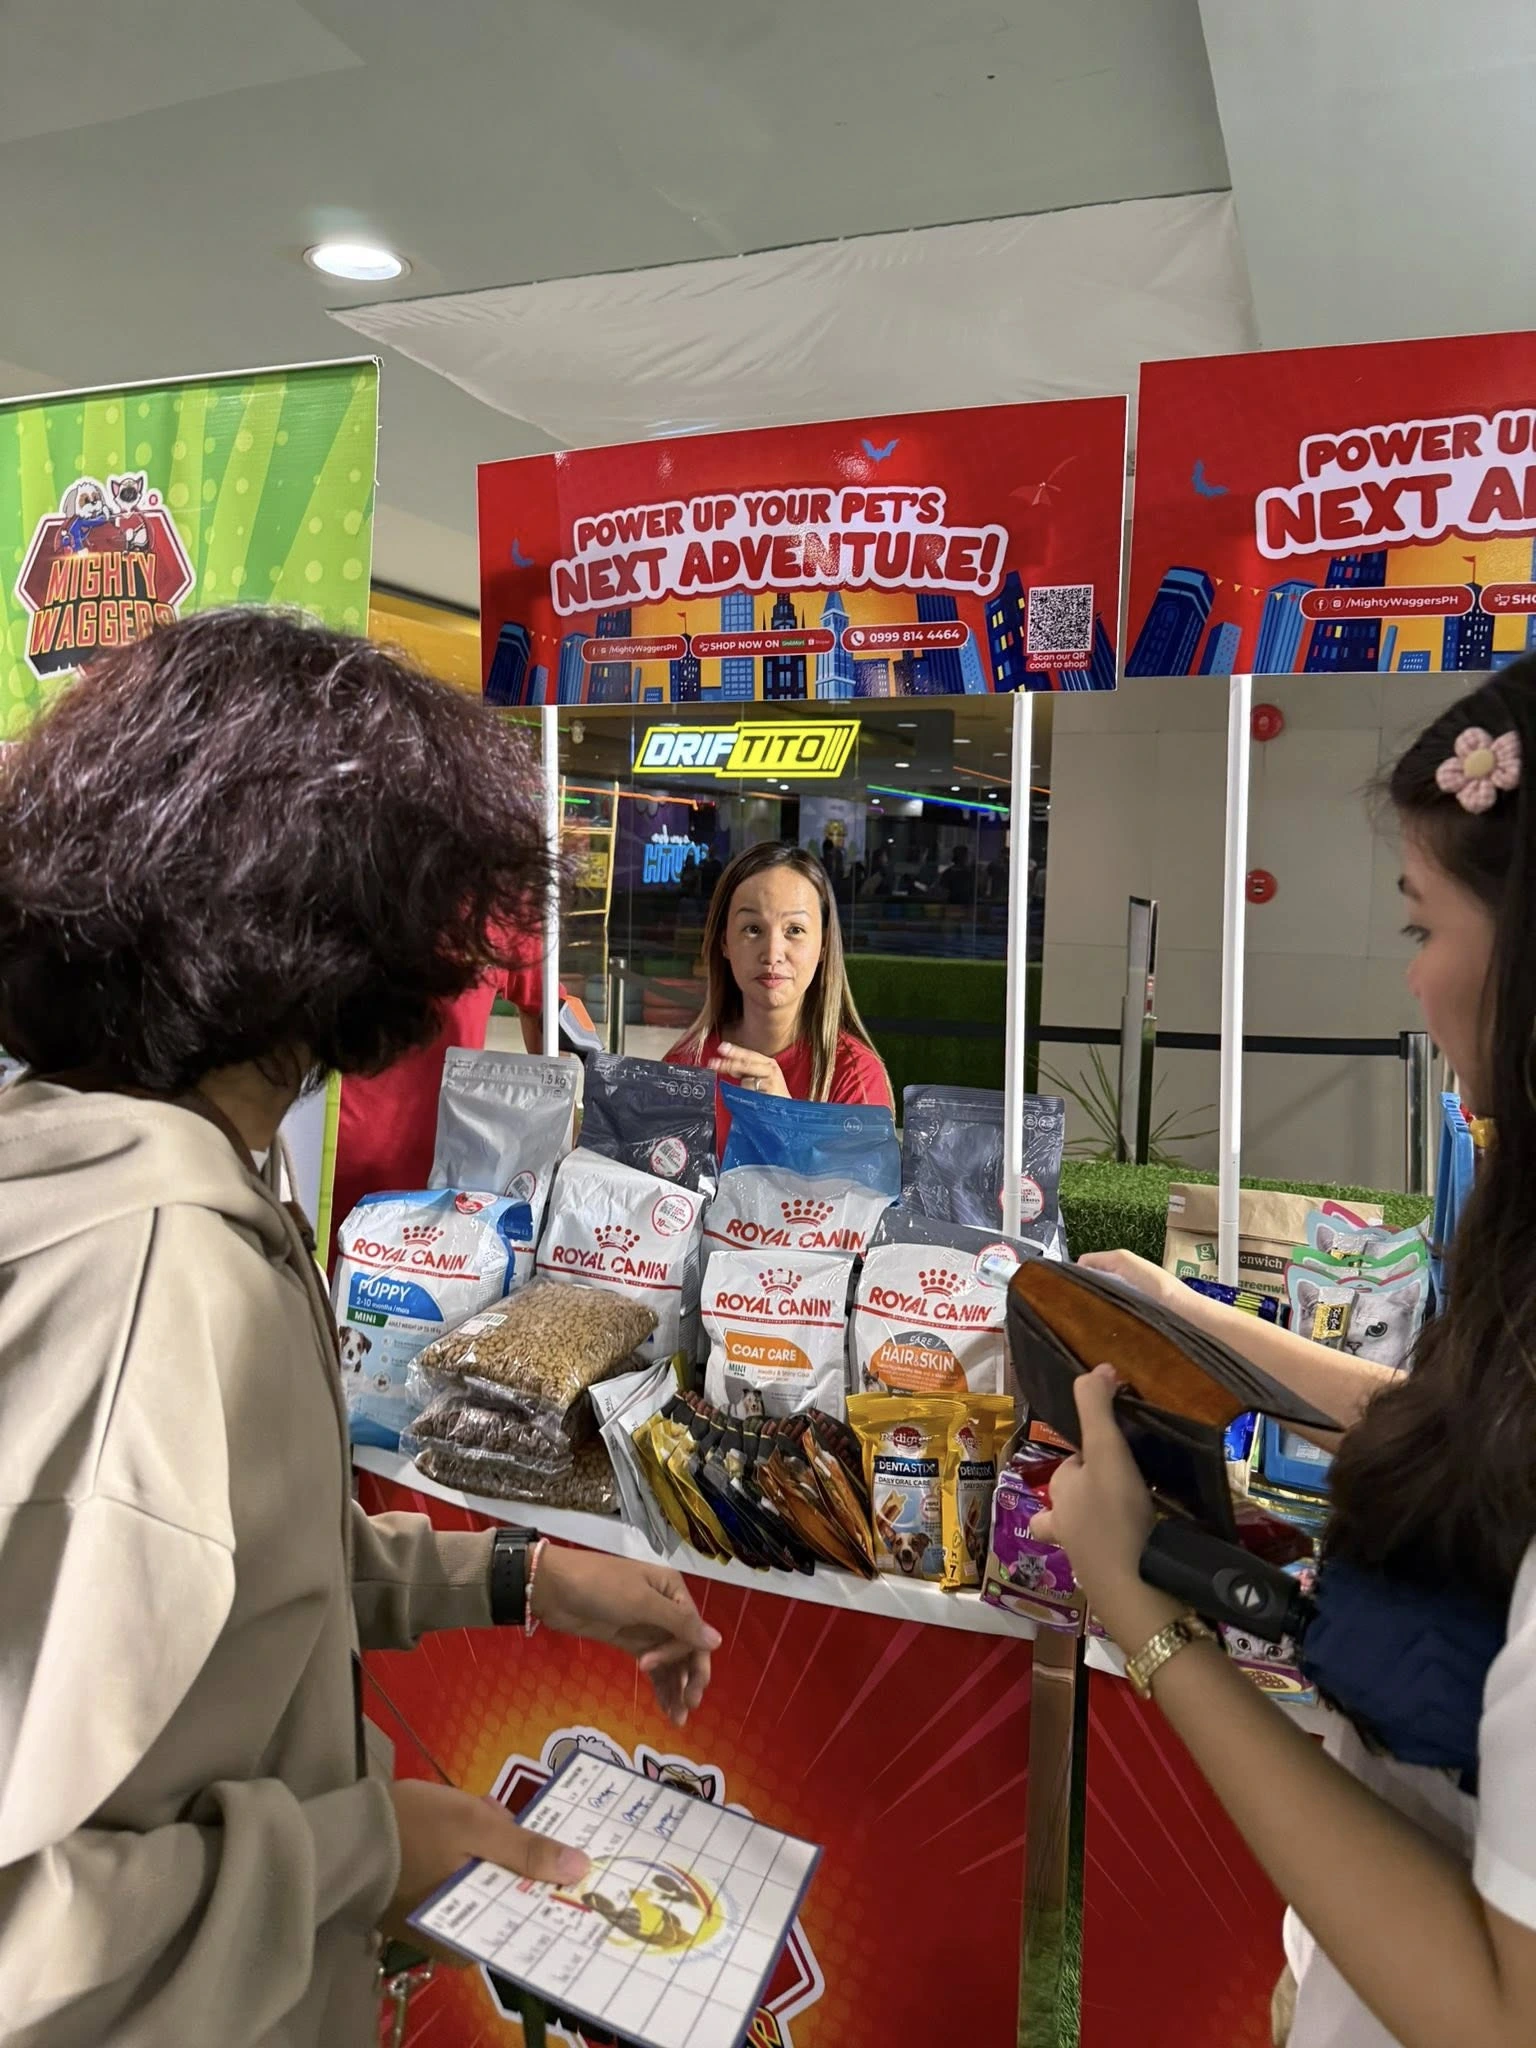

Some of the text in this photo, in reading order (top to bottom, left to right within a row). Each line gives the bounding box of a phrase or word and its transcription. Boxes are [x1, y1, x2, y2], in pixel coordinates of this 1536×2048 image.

[1306, 415, 1536, 478] POWER U
[1265, 473, 1452, 550] NEXT
[577, 491, 942, 552] POWER UP YOUR PET'S
[556, 531, 1001, 608] NEXT ADVENTURE!
[45, 551, 157, 606] MIGHTY
[1345, 595, 1458, 609] /MightyWaggersPH
[869, 629, 960, 643] 0999 814 4464
[711, 641, 736, 650] SHOP
[738, 640, 763, 649] NOW
[764, 639, 779, 648] ON
[1033, 653, 1055, 661] Scan
[1072, 652, 1086, 660] QR
[1030, 661, 1051, 669] code
[1063, 660, 1088, 669] shop!
[541, 1073, 567, 1089] 1.5 kg
[726, 1218, 866, 1250] ROYAL CANIN
[352, 1238, 407, 1263] ROYAL
[411, 1250, 470, 1271] CANIN
[1200, 1245, 1211, 1260] g
[552, 1245, 606, 1272] ROYAL
[611, 1256, 668, 1281] CANIN
[1239, 1254, 1283, 1269] enwich
[358, 1279, 411, 1302] PUPPY
[356, 1296, 372, 1307] 2-10
[716, 1291, 831, 1318] ROYAL CANIN
[868, 1286, 928, 1317] ROYAL
[934, 1302, 992, 1323] CANIN
[354, 1311, 377, 1324] MINI
[909, 1335, 933, 1345] CARE
[732, 1343, 797, 1361] COAT CARE
[728, 1363, 746, 1373] MINI
[879, 1460, 934, 1473] DENTASTIX
[895, 1478, 912, 1486] ORAL
